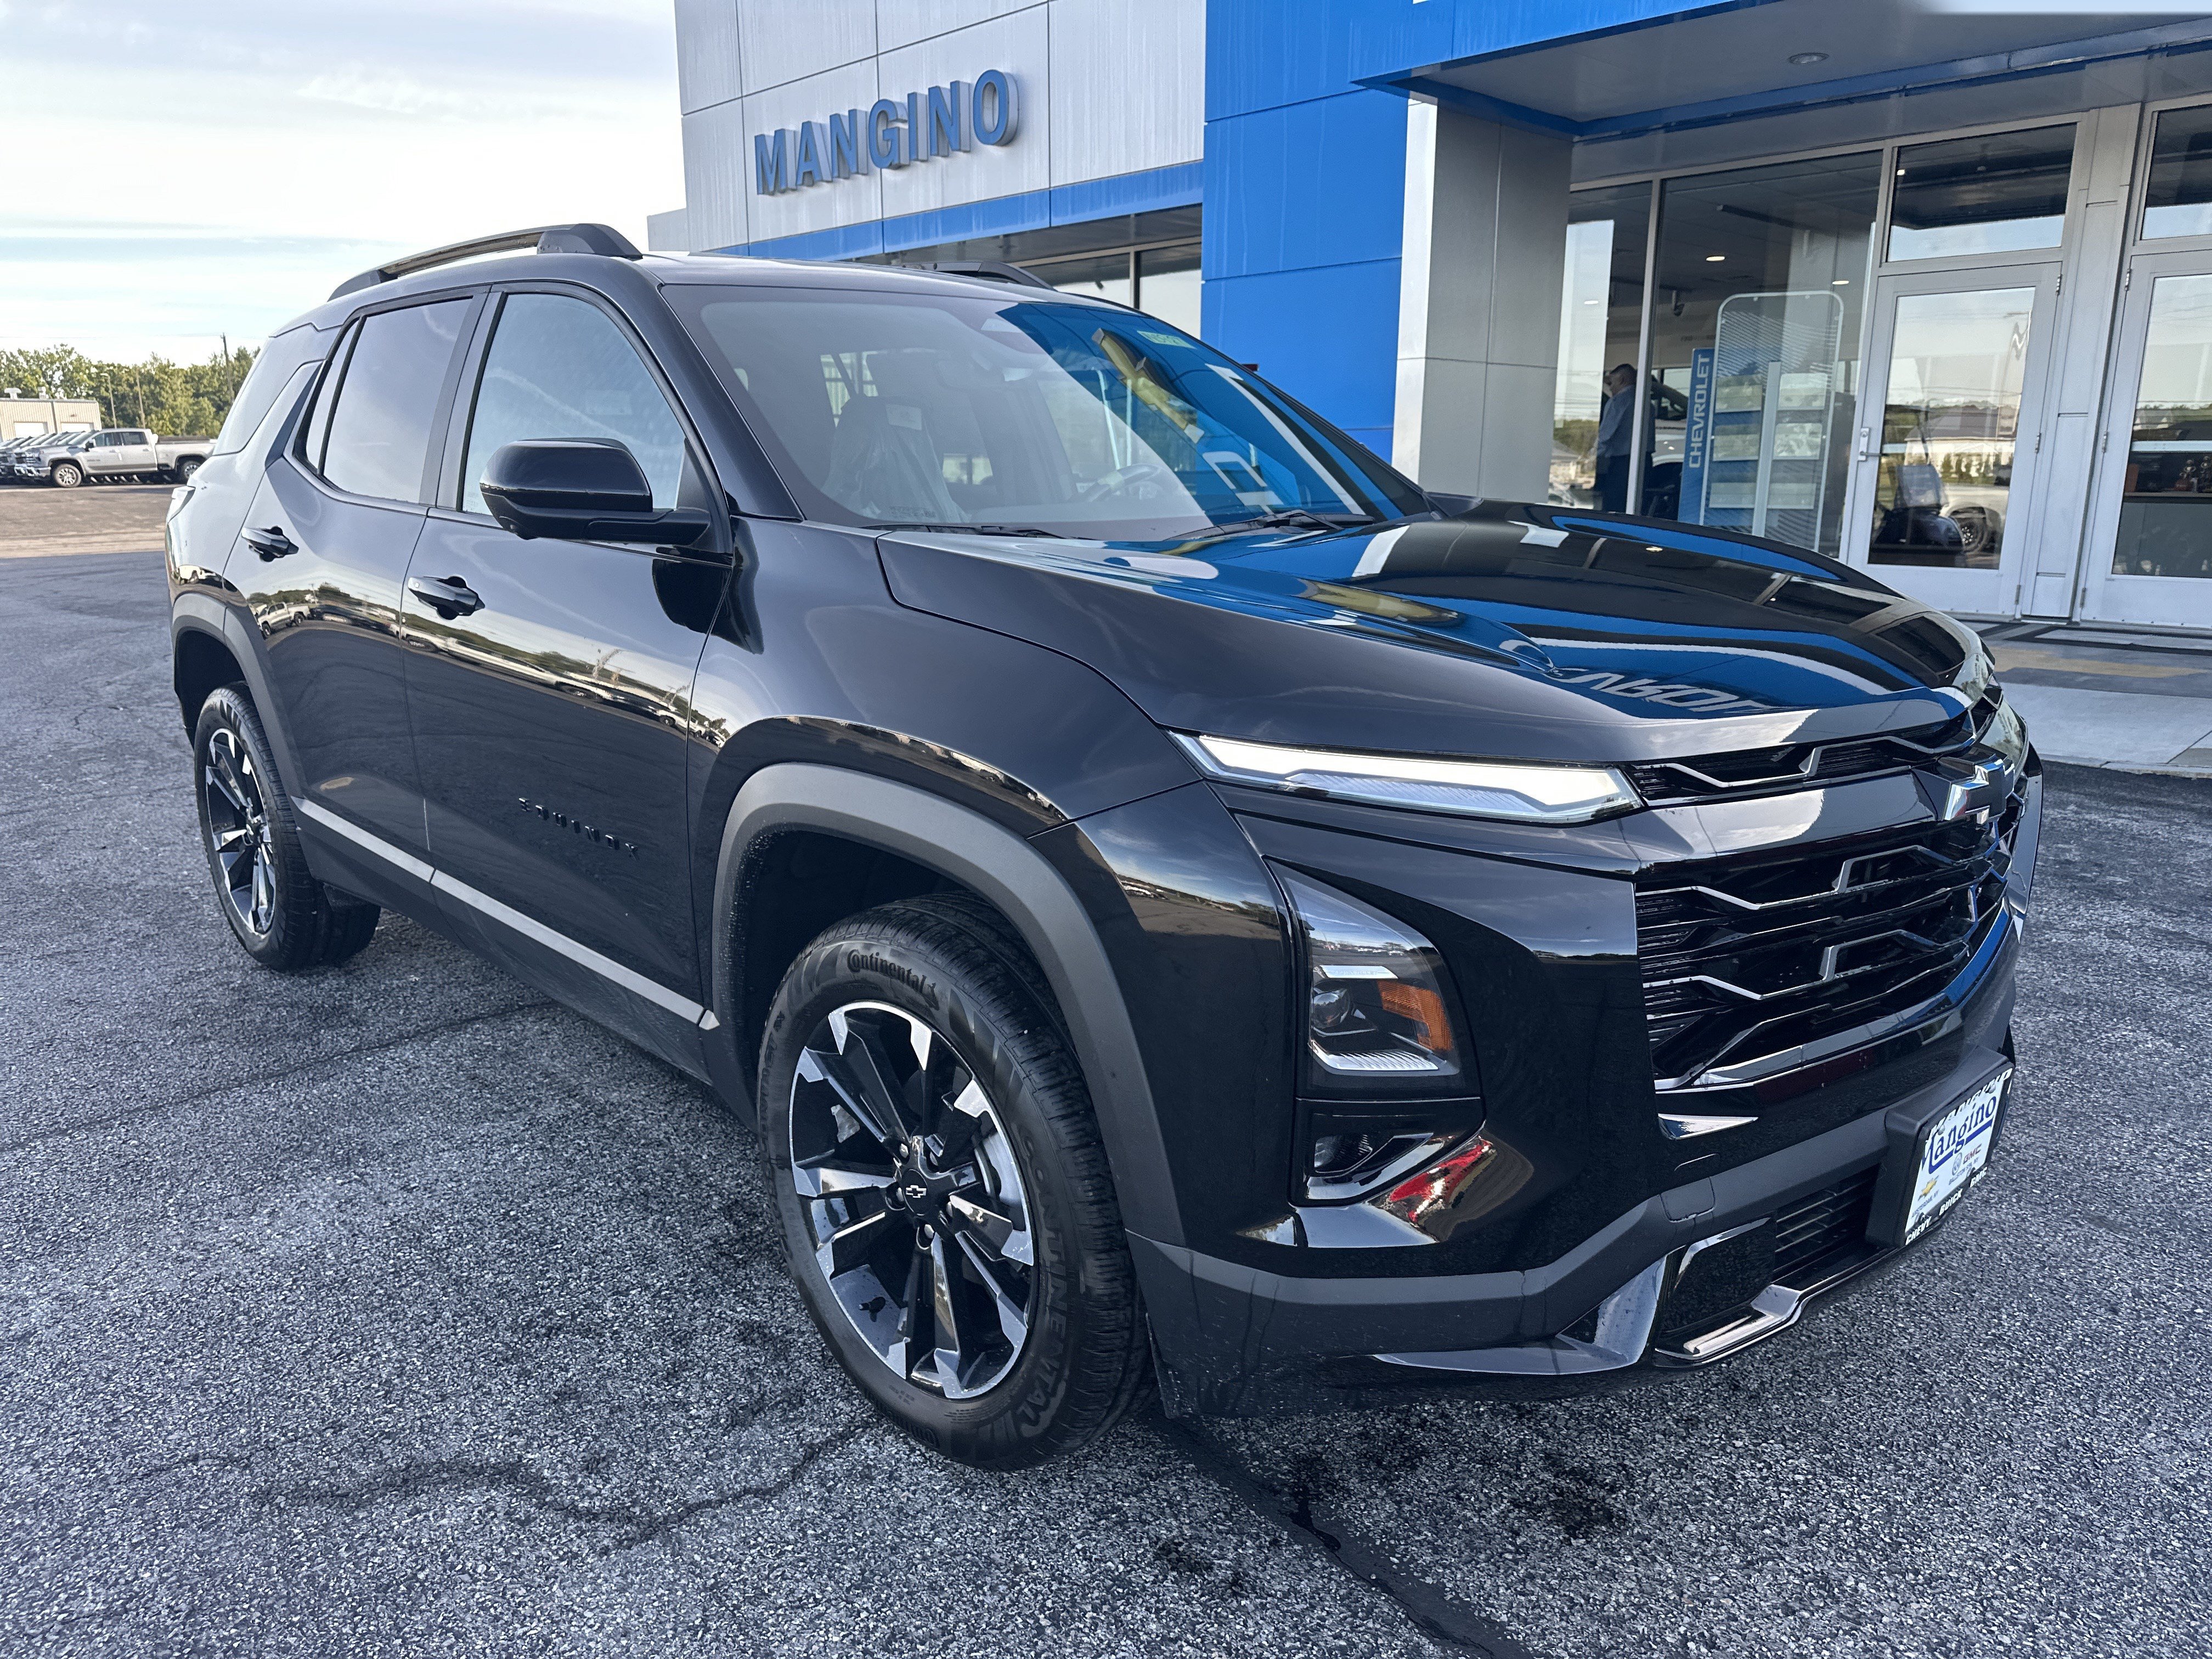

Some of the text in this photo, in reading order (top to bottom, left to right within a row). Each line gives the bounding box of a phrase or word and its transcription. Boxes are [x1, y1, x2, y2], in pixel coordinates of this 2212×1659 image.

[754, 69, 1019, 195] MANGINO
[1689, 354, 1710, 468] CHEVROLET
[847, 949, 927, 994] Continental
[1921, 1096, 1997, 1175] Mangino
[1962, 1143, 1982, 1165] GMC
[1905, 1166, 1988, 1245] CHEVY BUICK GMC
